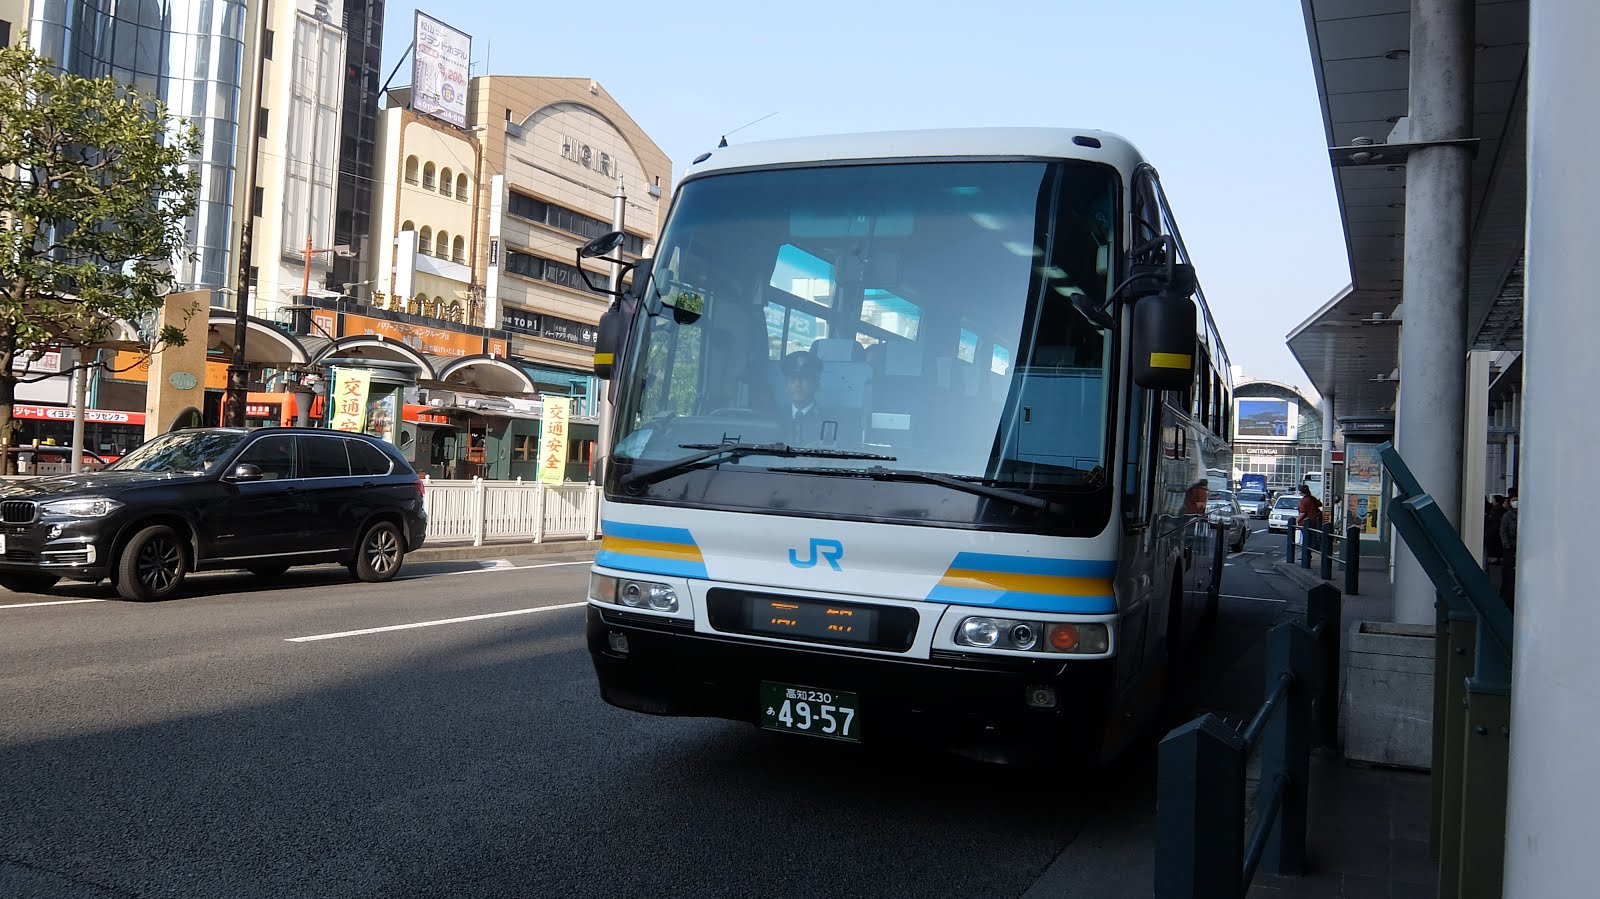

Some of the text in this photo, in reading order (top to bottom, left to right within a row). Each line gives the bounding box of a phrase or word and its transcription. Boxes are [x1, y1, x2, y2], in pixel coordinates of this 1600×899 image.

[419, 32, 468, 60] グランドホテル
[51, 410, 125, 421] イヨテツポーツセンター
[545, 404, 565, 469] 交通安全
[788, 537, 844, 572] JR
